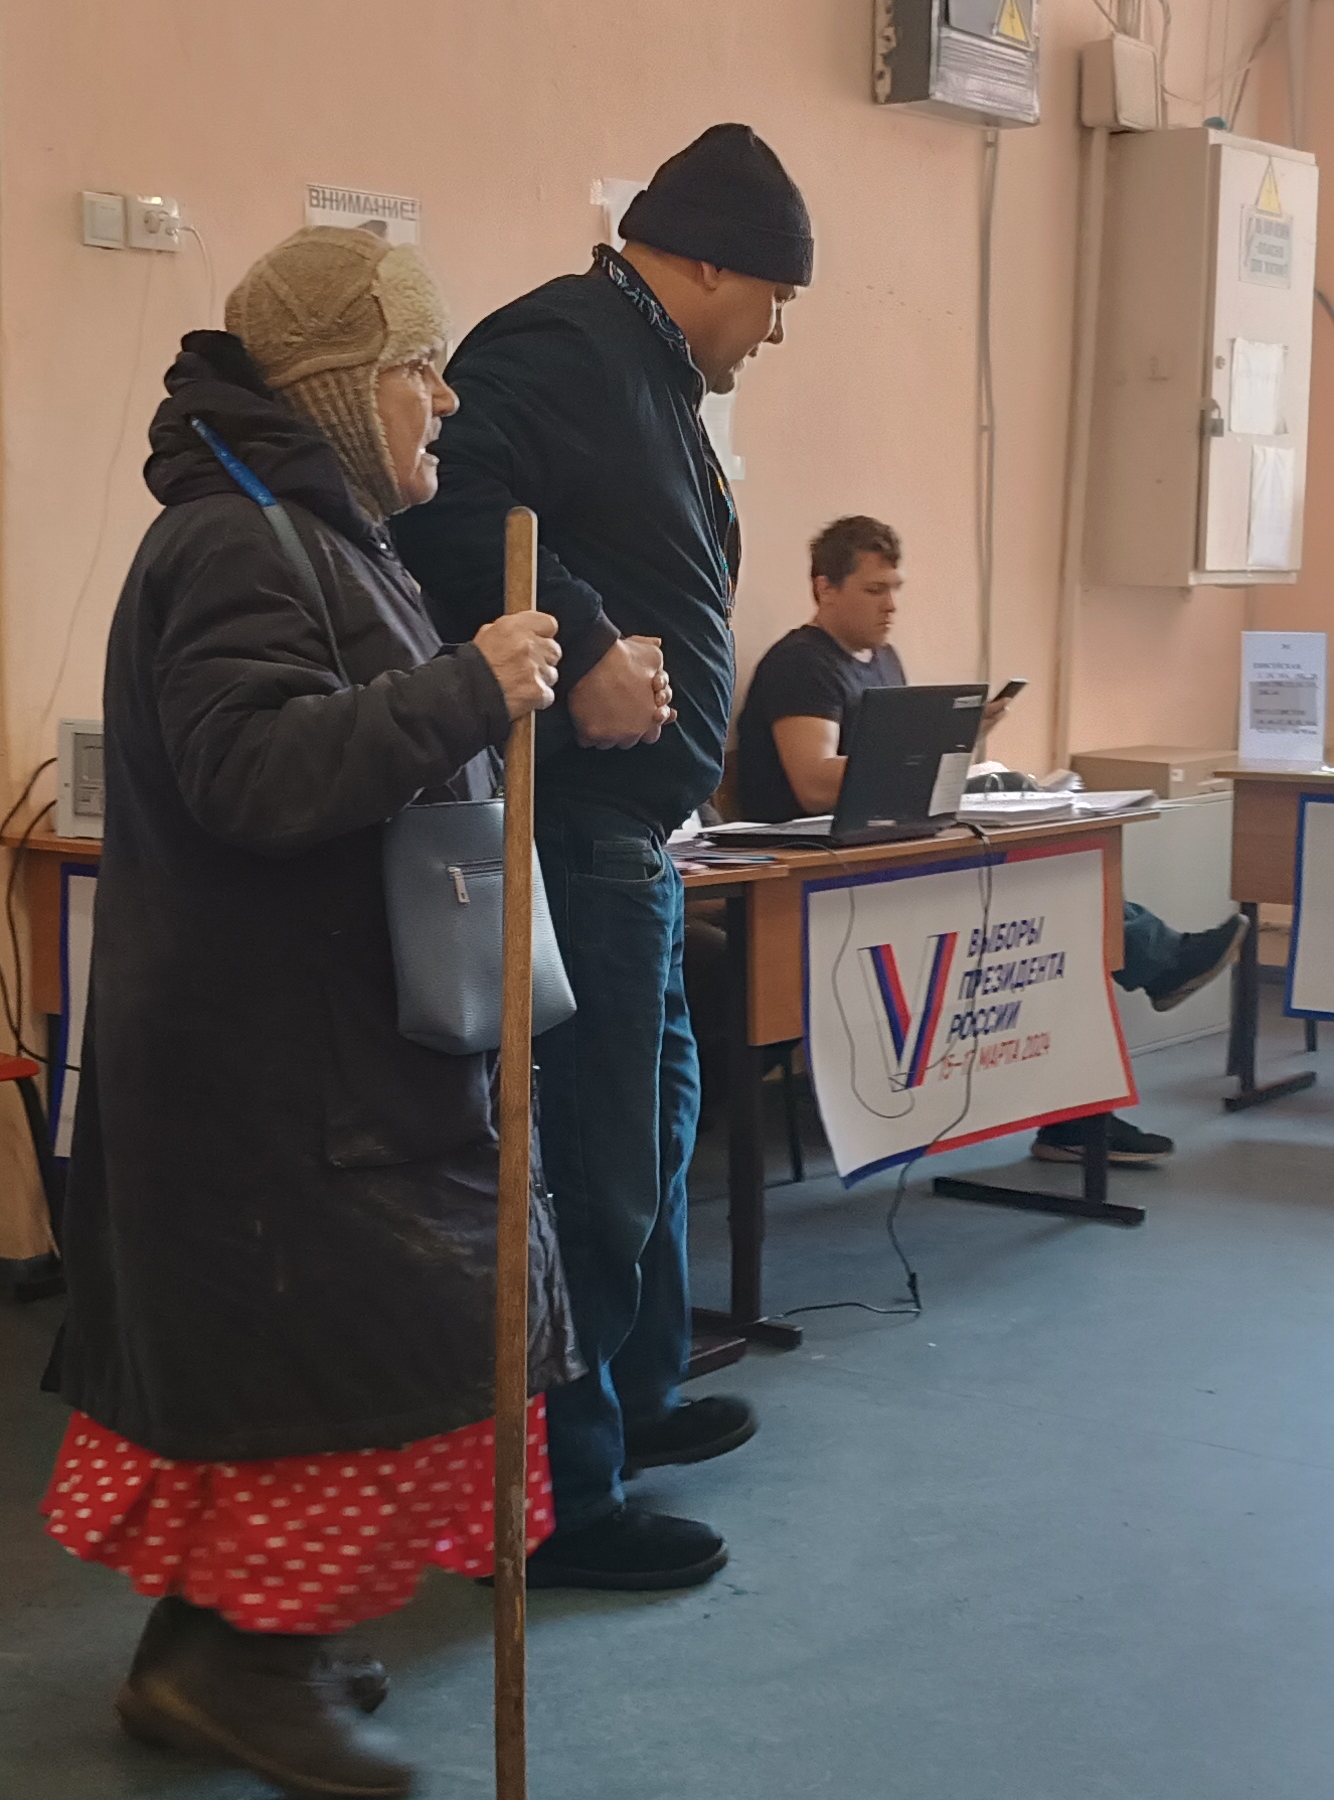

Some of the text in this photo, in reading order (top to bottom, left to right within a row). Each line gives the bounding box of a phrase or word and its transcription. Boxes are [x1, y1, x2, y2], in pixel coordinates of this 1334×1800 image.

[967, 916, 1045, 958] ВЫБОРЫ
[958, 951, 1065, 1000] ПРЕЗИДЕНТА
[945, 1000, 1023, 1044] РОССИИ
